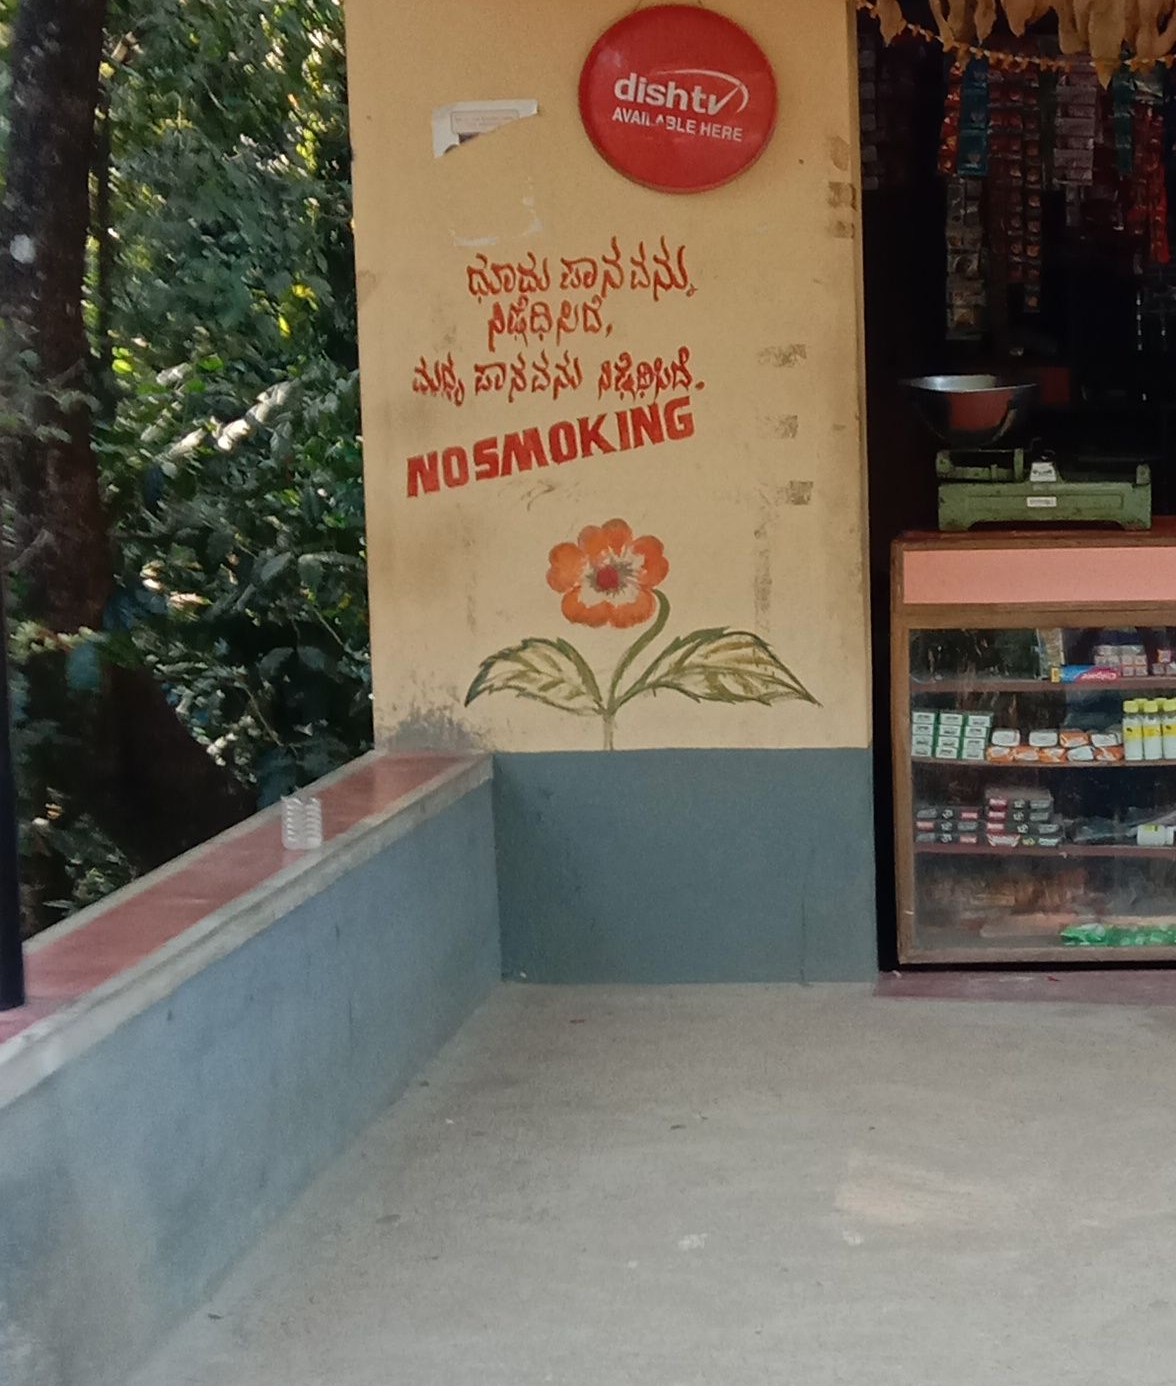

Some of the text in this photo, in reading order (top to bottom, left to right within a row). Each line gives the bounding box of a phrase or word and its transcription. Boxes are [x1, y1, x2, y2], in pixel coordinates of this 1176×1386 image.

[614, 72, 740, 115] dishtv
[612, 107, 743, 142] AVAILABLE HERE
